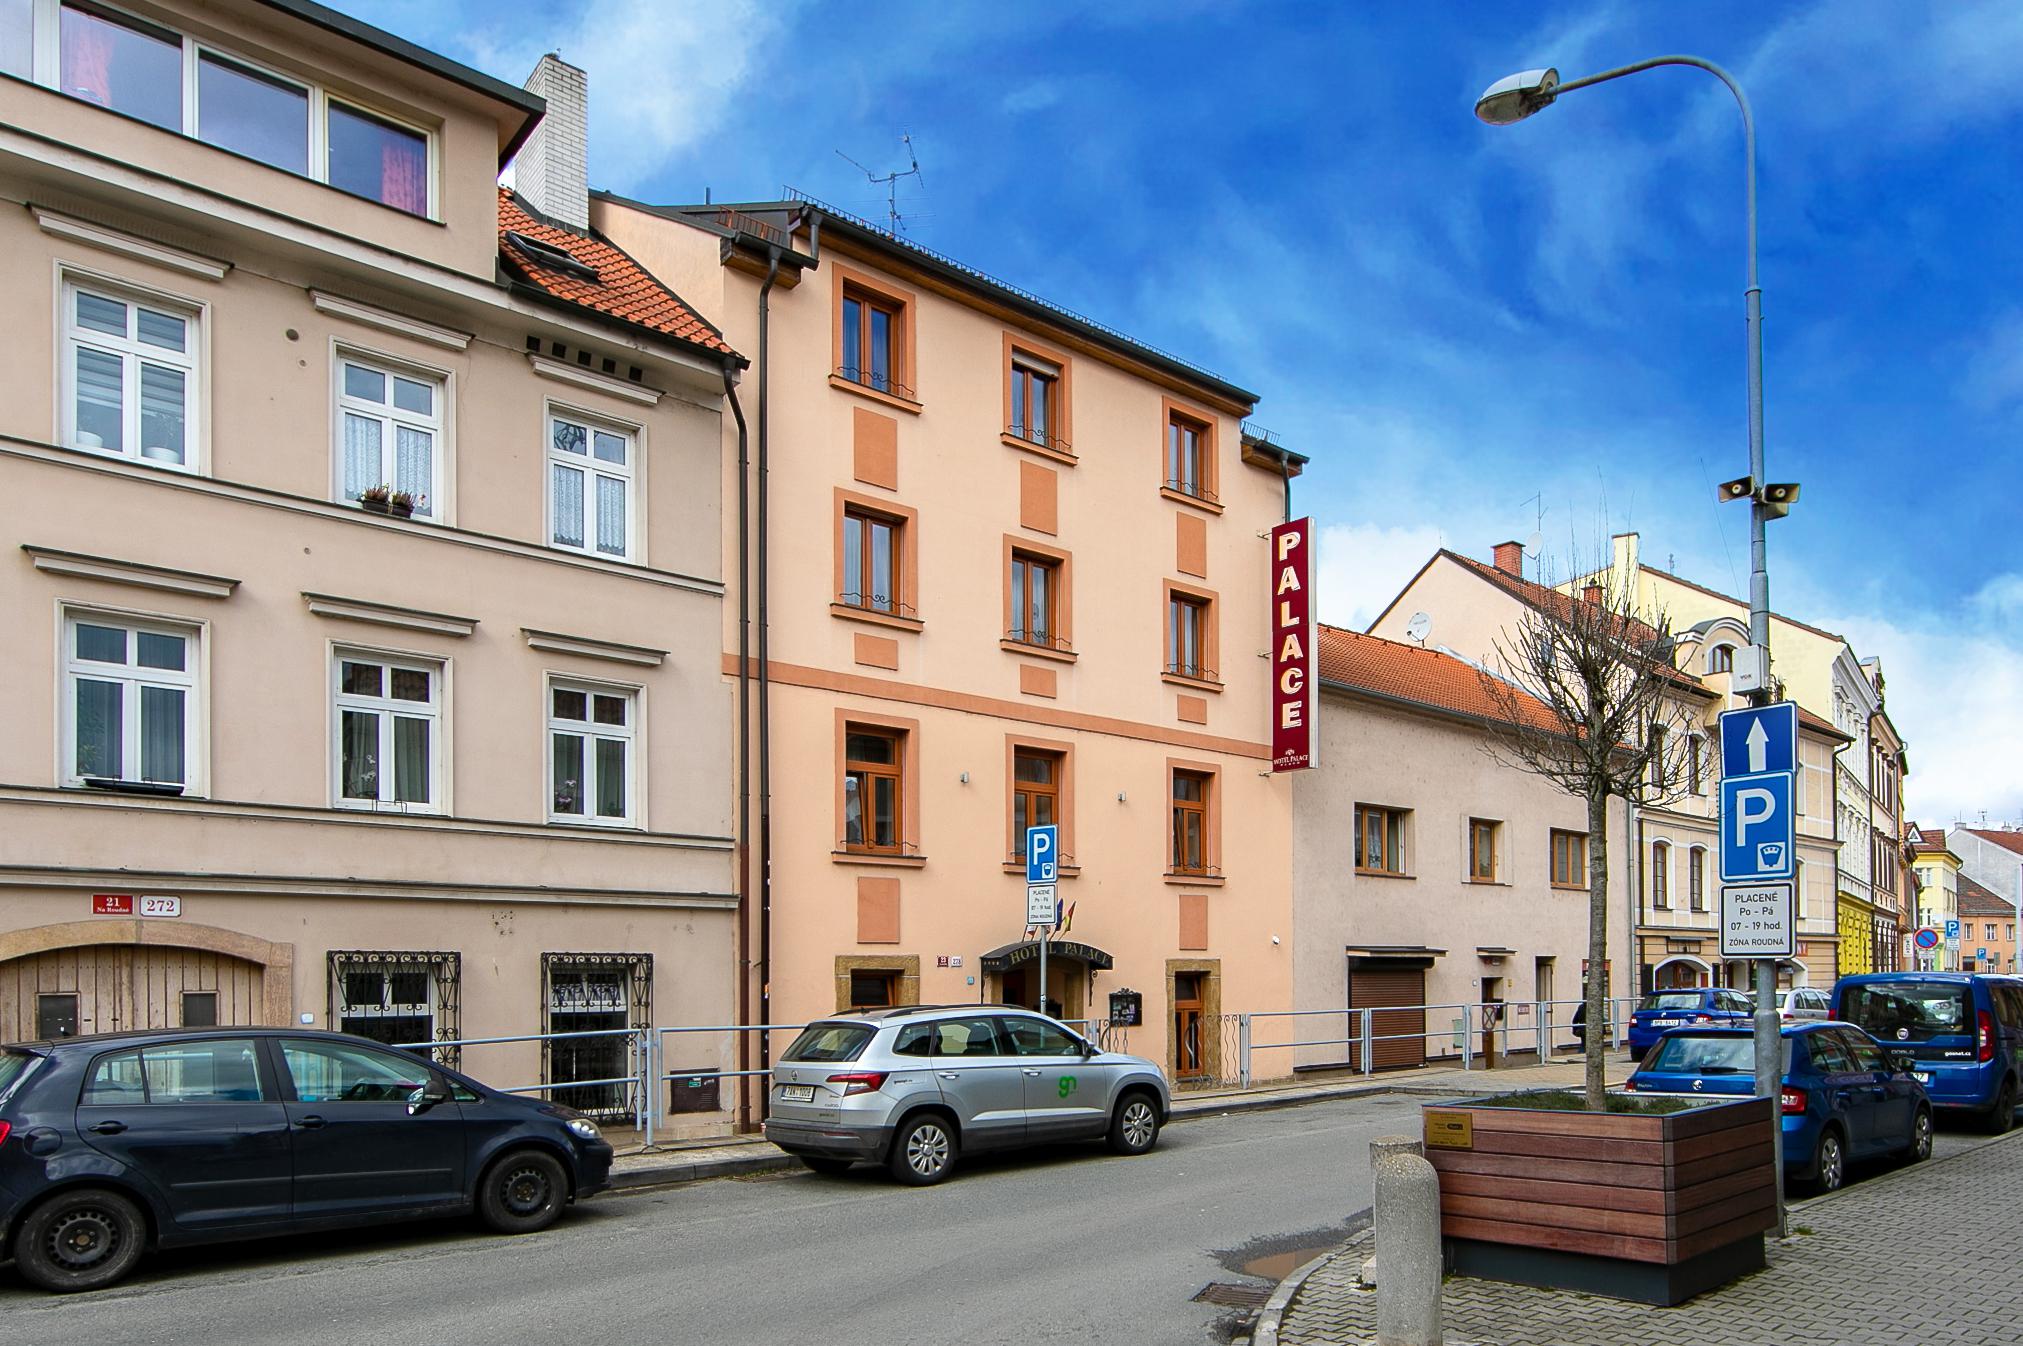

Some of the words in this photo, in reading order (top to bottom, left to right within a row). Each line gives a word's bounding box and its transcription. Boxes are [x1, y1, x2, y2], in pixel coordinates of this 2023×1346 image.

[1277, 531, 1304, 729] PALACE
[1736, 788, 1776, 847] P
[1033, 833, 1050, 866] P
[106, 897, 120, 907] 21
[1734, 891, 1778, 903] PLACENÉ
[147, 900, 175, 912] 272
[1739, 907, 1751, 916] Po
[1762, 906, 1774, 916] Pá
[1730, 922, 1742, 931] 07
[1752, 921, 1761, 931] 19
[1763, 921, 1783, 930] hod.
[1948, 922, 1958, 933] P
[1728, 937, 1750, 946] ZÓNA
[1751, 937, 1785, 946] ROUDNÁ
[1010, 943, 1056, 964] HOTL
[1065, 943, 1111, 965] PALACE
